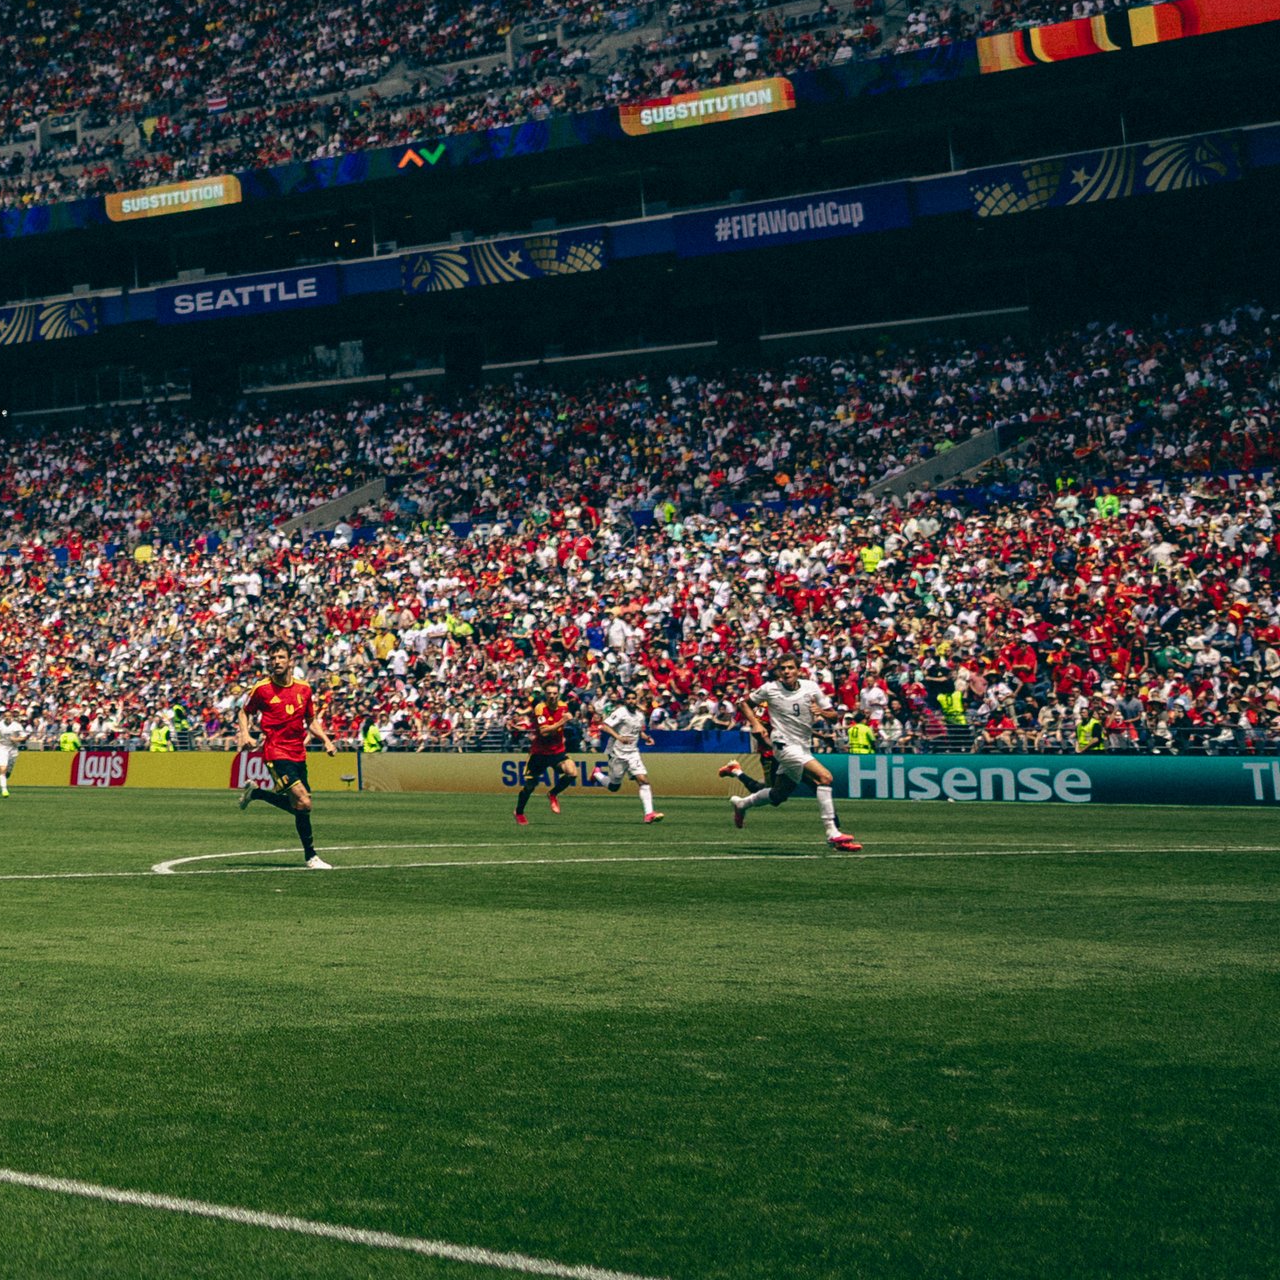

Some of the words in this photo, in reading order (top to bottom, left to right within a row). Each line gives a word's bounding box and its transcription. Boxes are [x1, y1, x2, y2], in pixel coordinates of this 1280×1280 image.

[640, 87, 772, 126] SUBSTITUTION
[122, 184, 224, 213] SUBSTITUTION
[715, 201, 864, 242] #FIFAWorldCup
[174, 277, 317, 314] SEATTLE
[792, 703, 801, 717] 9
[76, 750, 123, 787] Lay's
[848, 755, 1092, 802] Hisense
